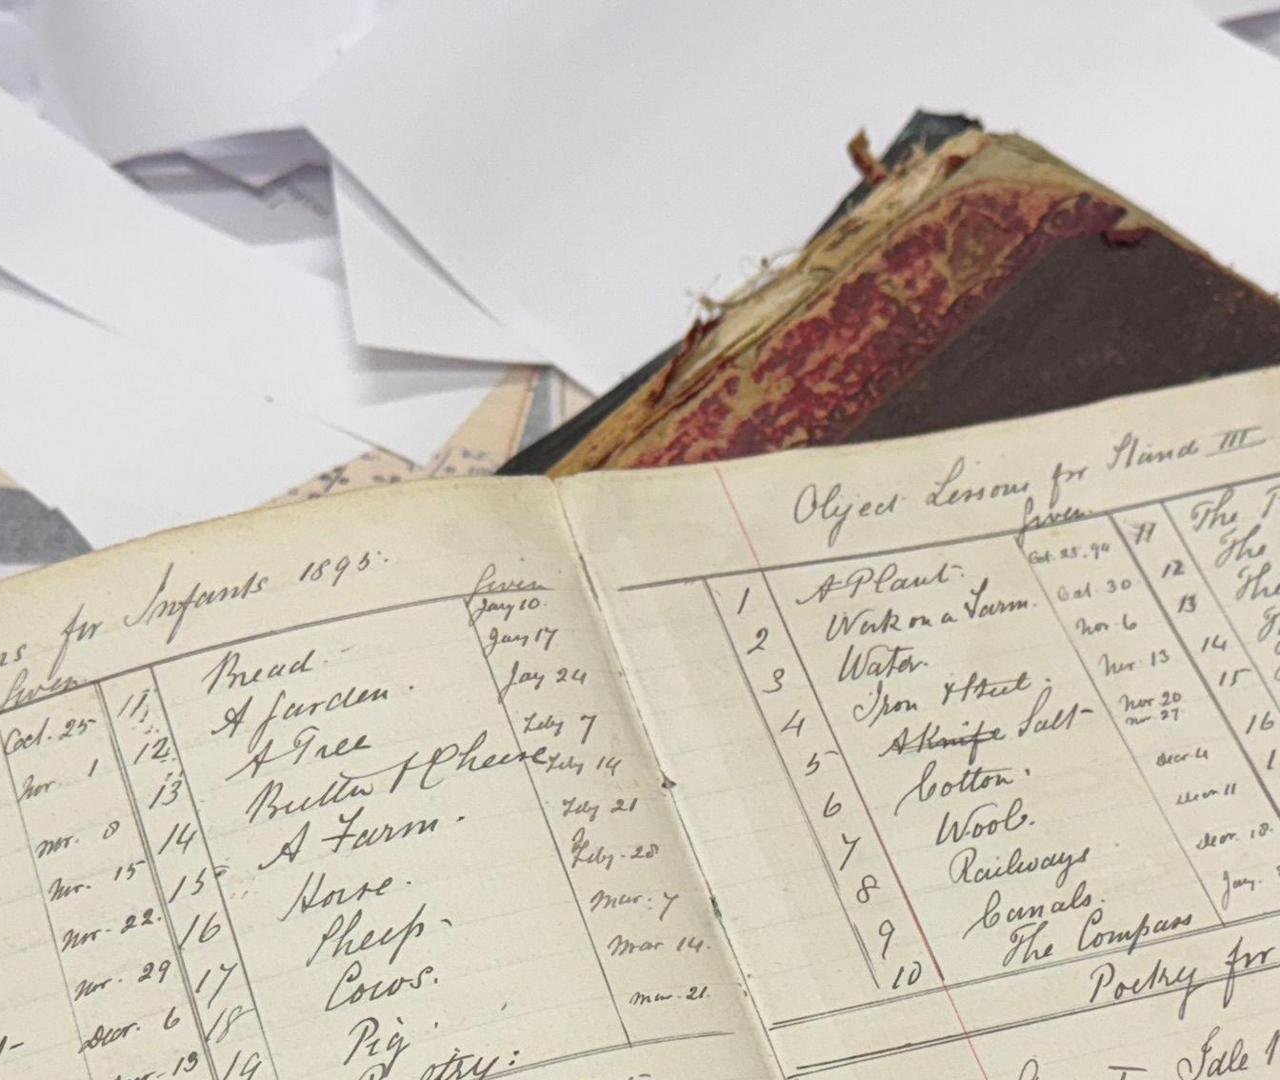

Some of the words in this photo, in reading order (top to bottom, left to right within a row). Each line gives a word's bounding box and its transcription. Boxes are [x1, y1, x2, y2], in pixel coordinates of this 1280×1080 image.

[793, 483, 898, 548] Object
[924, 456, 1031, 508] Lessons
[1049, 461, 1091, 510] for
[1190, 488, 1239, 534] The
[1161, 560, 1187, 579] 12
[1214, 527, 1267, 569] The
[737, 587, 752, 615] 1
[1176, 593, 1198, 615] 13
[49, 604, 105, 688] for
[123, 562, 271, 645] Infants
[746, 627, 769, 657] 2
[1201, 636, 1228, 654] 14
[762, 668, 786, 695] 3
[1218, 668, 1253, 688] 15
[117, 689, 150, 723] 11
[779, 709, 806, 738] 4
[1245, 711, 1276, 735] 16
[132, 736, 172, 765] 12
[148, 779, 183, 811] 13
[292, 725, 373, 767] Tree
[822, 791, 842, 819] 6
[157, 822, 200, 857] 14
[167, 867, 229, 904] 15
[321, 805, 441, 854] Farm
[839, 832, 862, 872] 7
[856, 874, 881, 905] 8
[948, 846, 1091, 888] Railways
[178, 911, 223, 952] 16
[877, 919, 897, 960] 9
[137, 958, 173, 984] 29
[195, 961, 240, 1010] 17
[305, 903, 427, 969] Sheep
[891, 960, 923, 991] 10
[1001, 921, 1055, 967] The
[1088, 958, 1201, 1020] Poetry
[1222, 936, 1278, 1010] for
[162, 1006, 182, 1031] 6
[205, 1004, 250, 1043] 18
[342, 1016, 411, 1068] Pig
